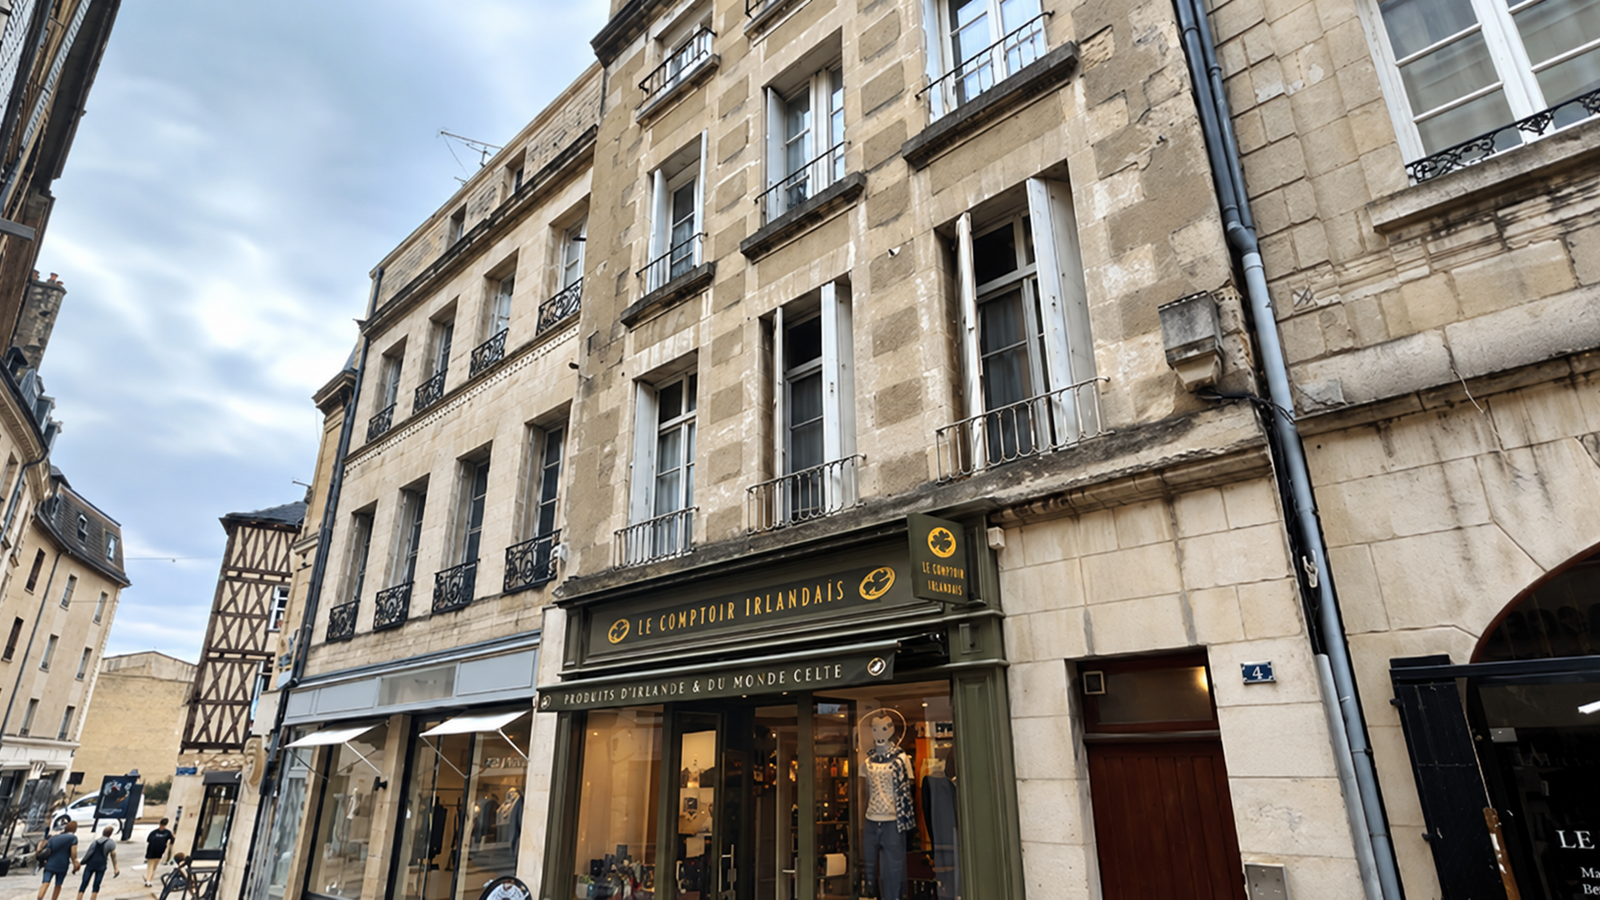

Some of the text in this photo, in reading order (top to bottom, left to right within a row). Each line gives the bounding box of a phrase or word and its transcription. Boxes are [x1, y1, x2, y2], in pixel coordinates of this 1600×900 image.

[922, 561, 930, 574] LE
[638, 578, 845, 636] LE COMPTOIR IRLANDAIS
[1252, 665, 1264, 680] 4
[564, 664, 842, 705] PRODUITS D'IRLANDE & DU MONDE CELTE
[1555, 829, 1595, 849] LE
